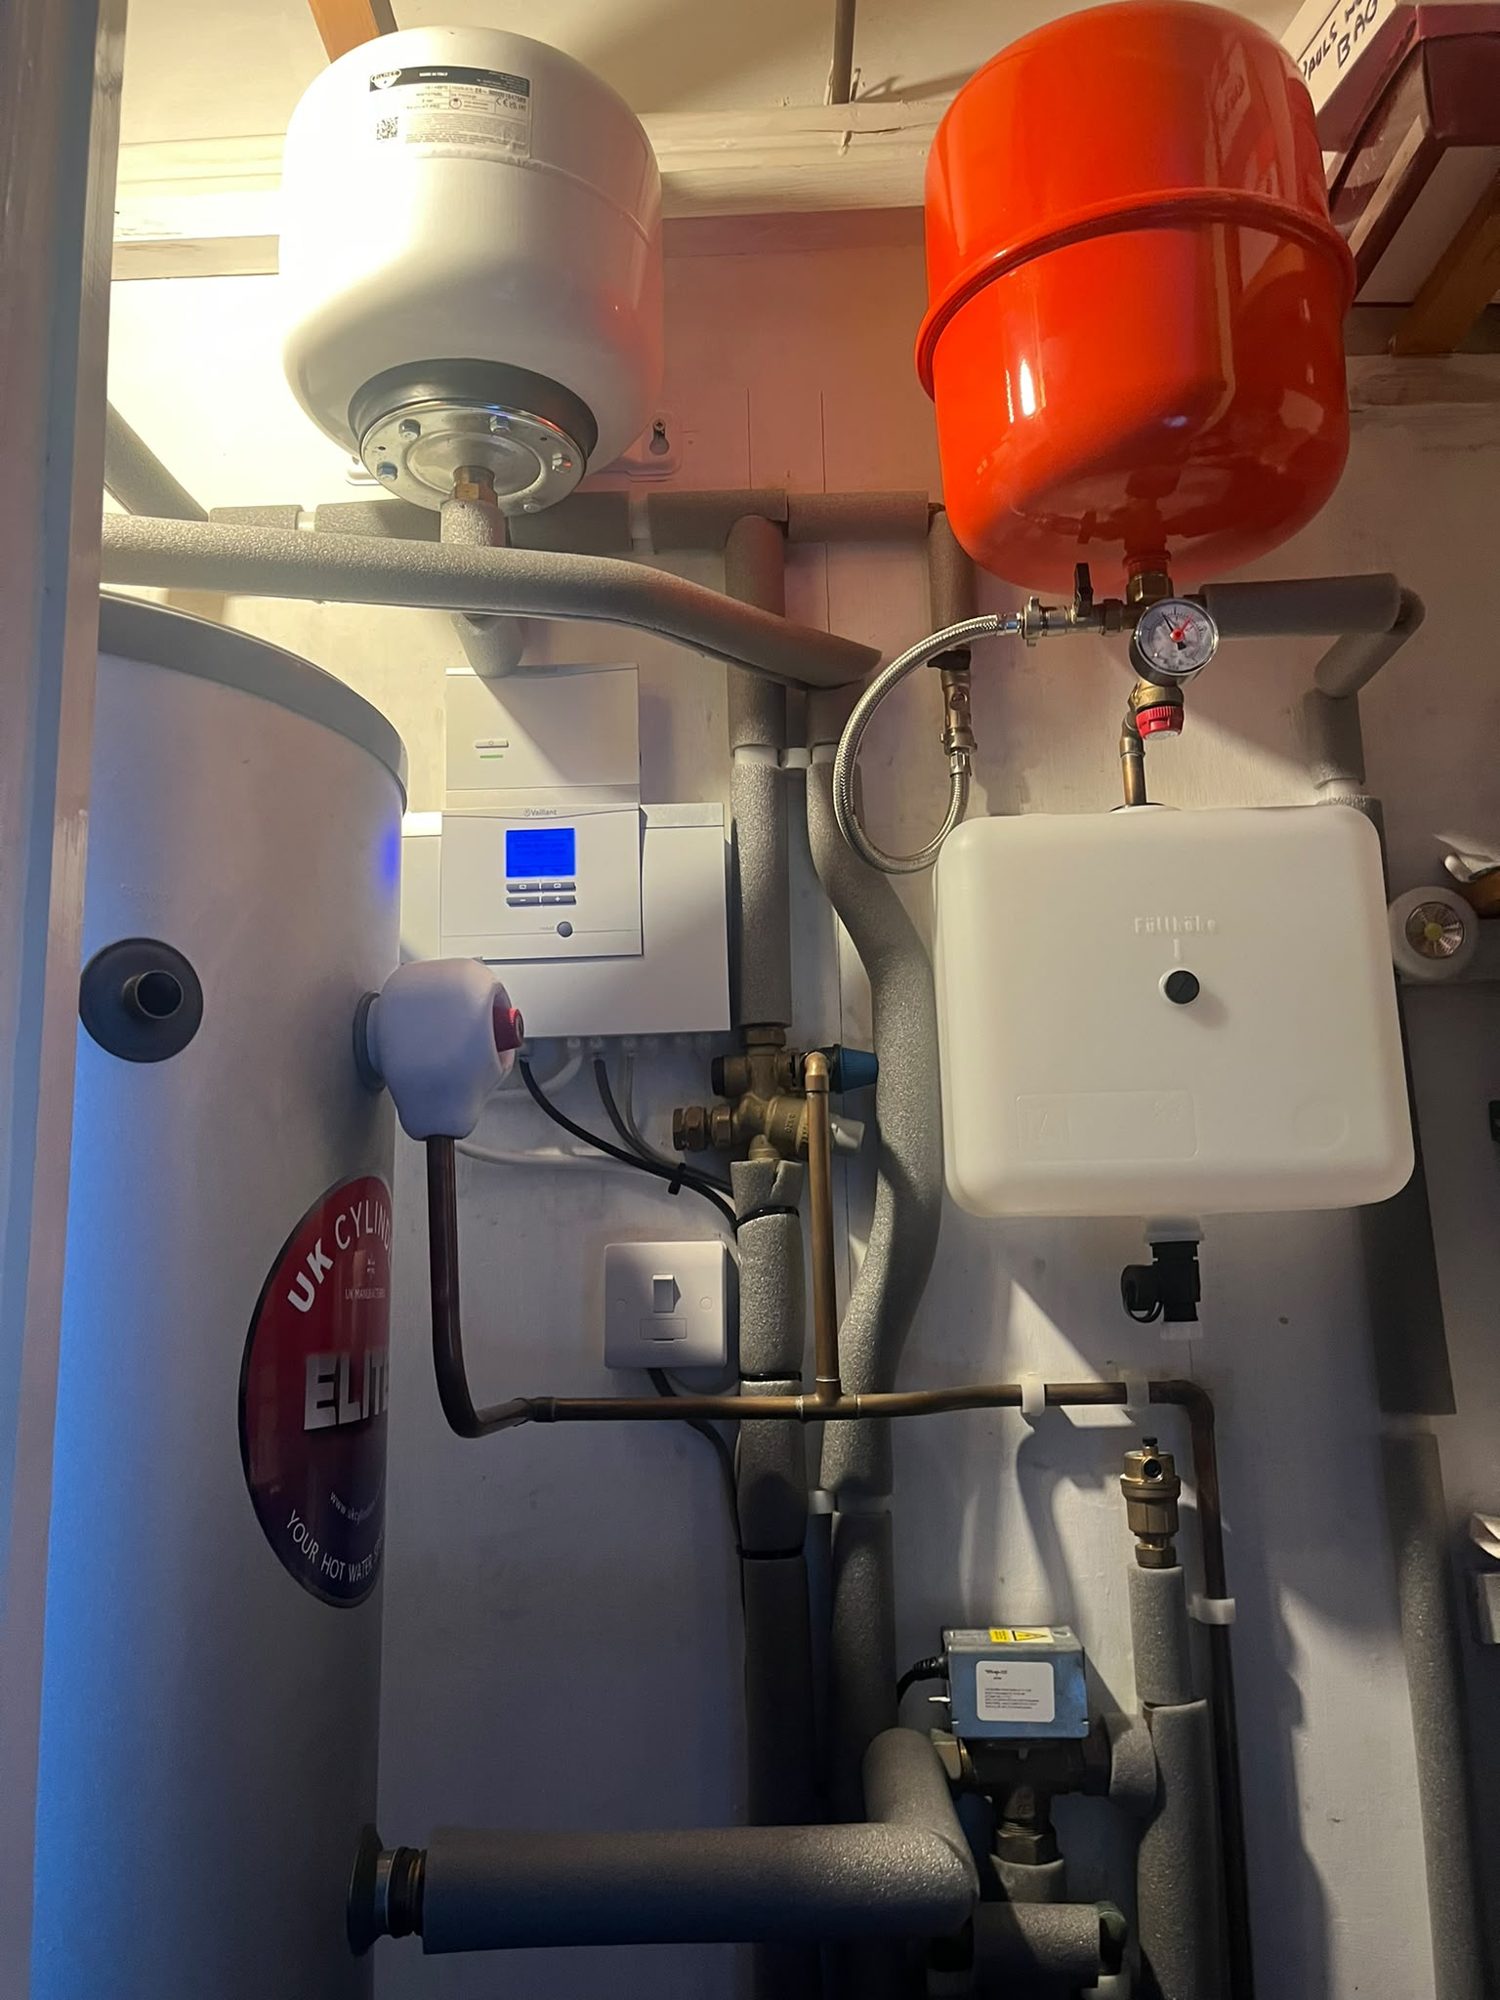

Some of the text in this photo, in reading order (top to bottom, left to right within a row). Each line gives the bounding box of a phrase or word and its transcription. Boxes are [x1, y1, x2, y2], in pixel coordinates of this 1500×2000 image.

[530, 808, 558, 816] Vaillant
[287, 1237, 335, 1313] UK
[286, 1508, 320, 1564] YOUR
[320, 1551, 345, 1582] HOT
